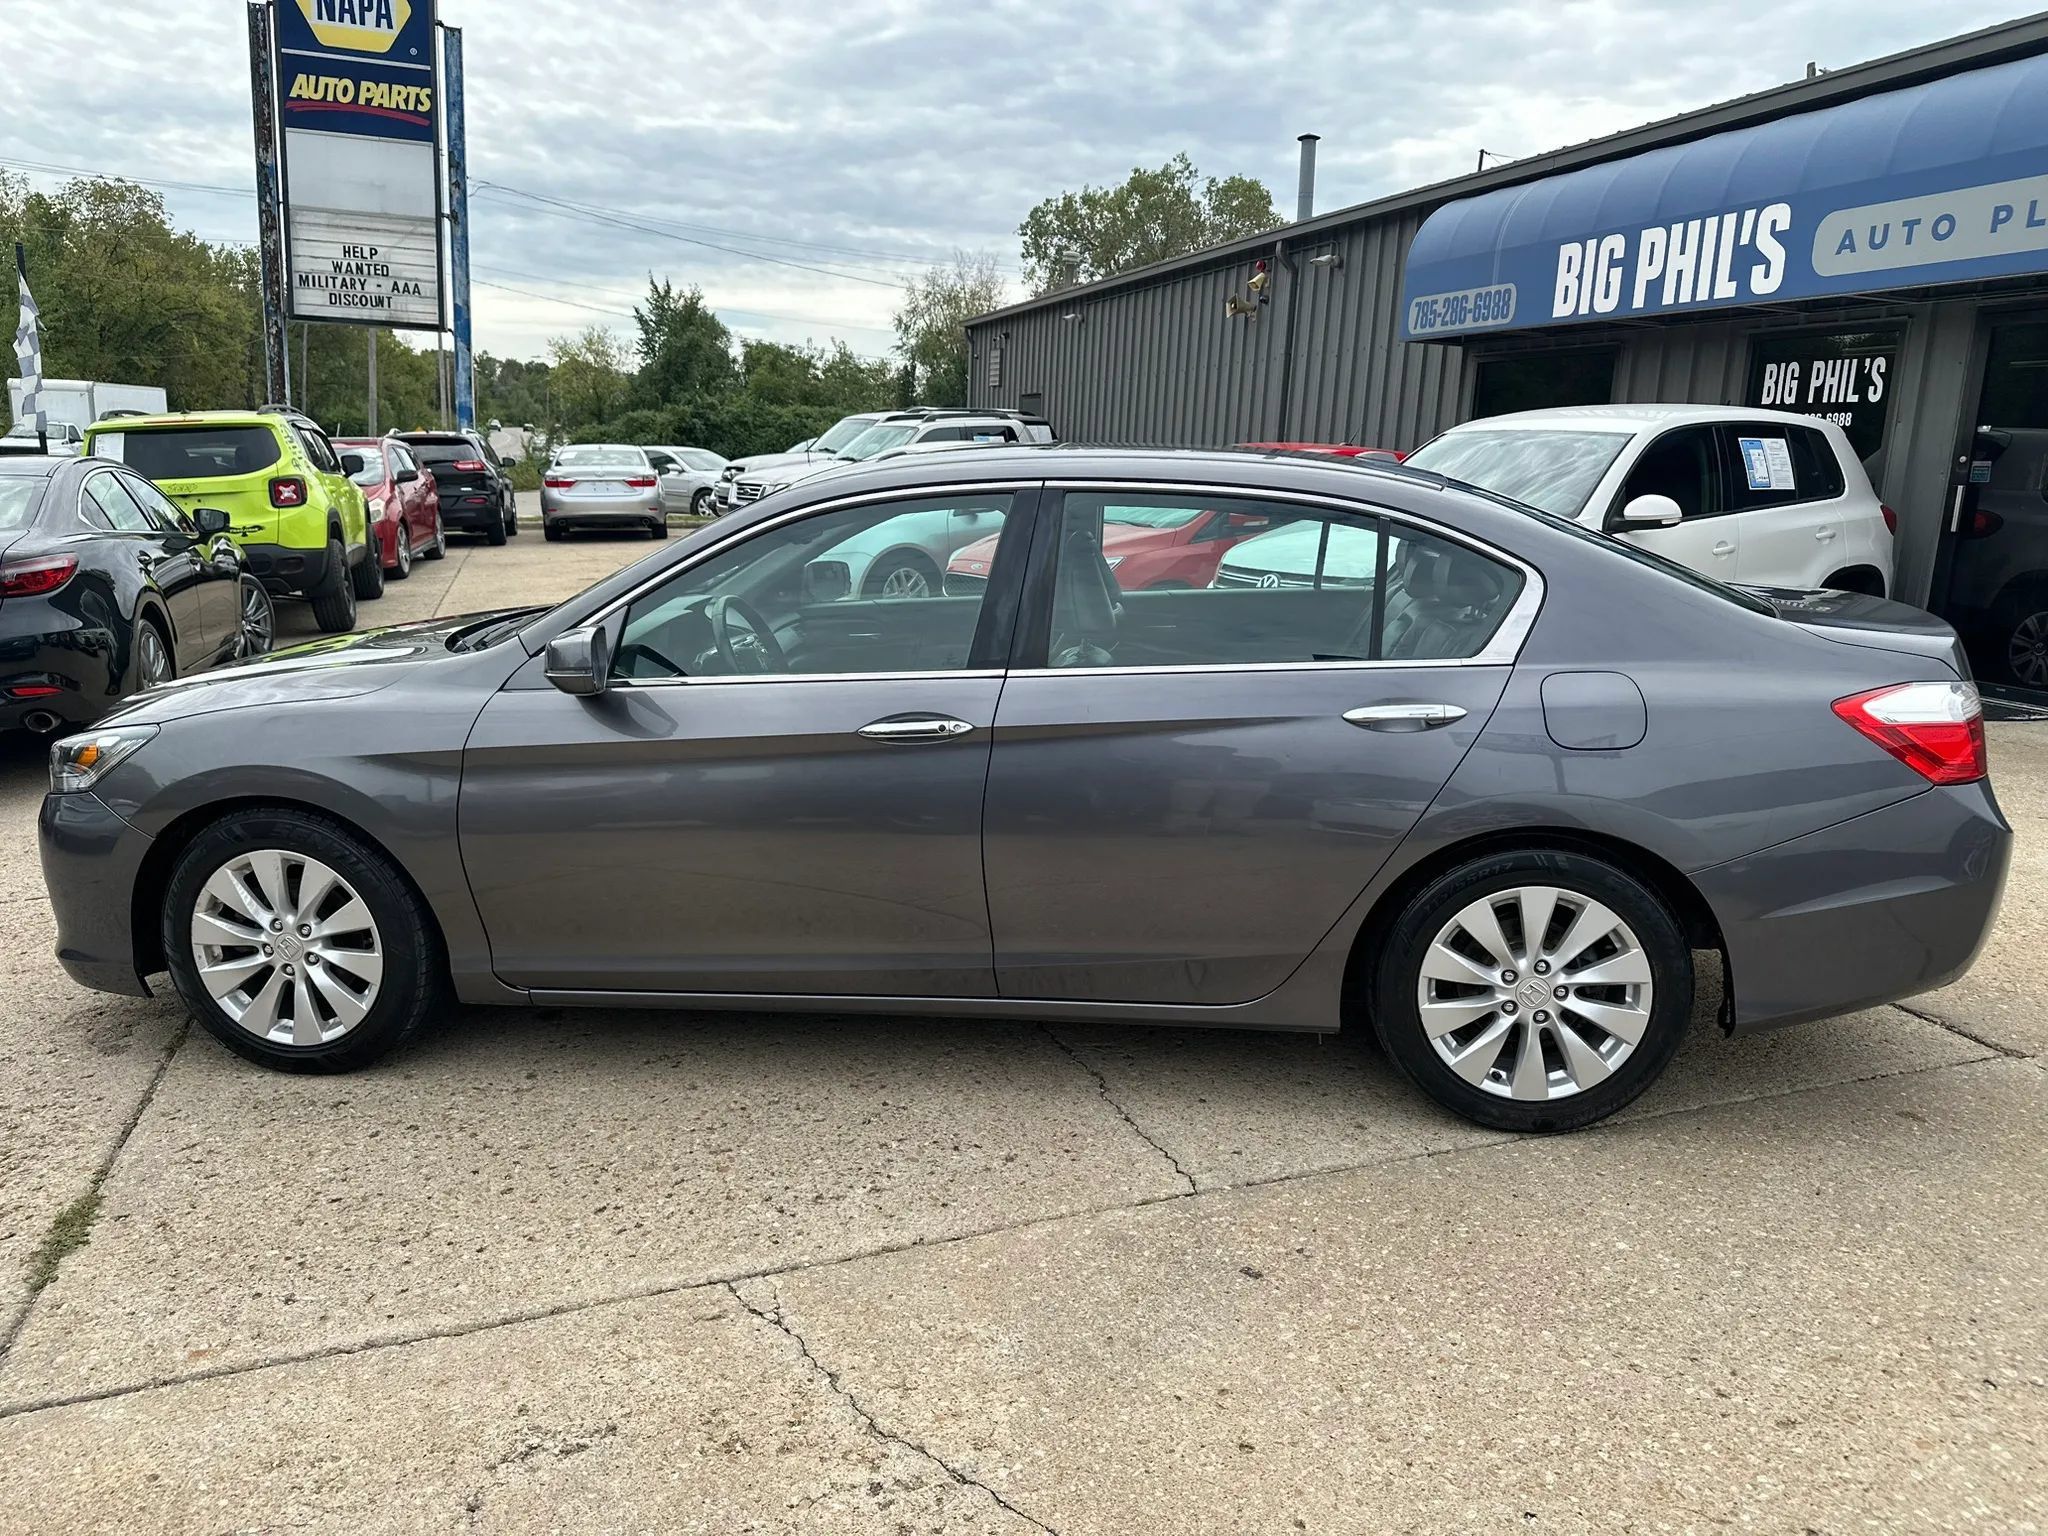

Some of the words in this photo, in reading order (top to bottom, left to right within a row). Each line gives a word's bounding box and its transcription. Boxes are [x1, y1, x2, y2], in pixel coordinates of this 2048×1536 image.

[316, 0, 394, 30] NAPA
[289, 73, 355, 104] AUTO
[358, 80, 431, 112] PARTS
[1835, 213, 1957, 256] AUTO
[332, 260, 390, 277] WANTED
[343, 245, 378, 260] HELP
[1552, 233, 1626, 319] BIG
[1632, 202, 1792, 310] PHIL'S
[299, 274, 367, 291] MILITARY
[391, 281, 421, 296] AAA
[329, 292, 393, 309] DISCOUNT
[1413, 287, 1512, 331] 785-286-6988
[1760, 361, 1800, 405] BIG
[1807, 356, 1887, 404] PHIL'S
